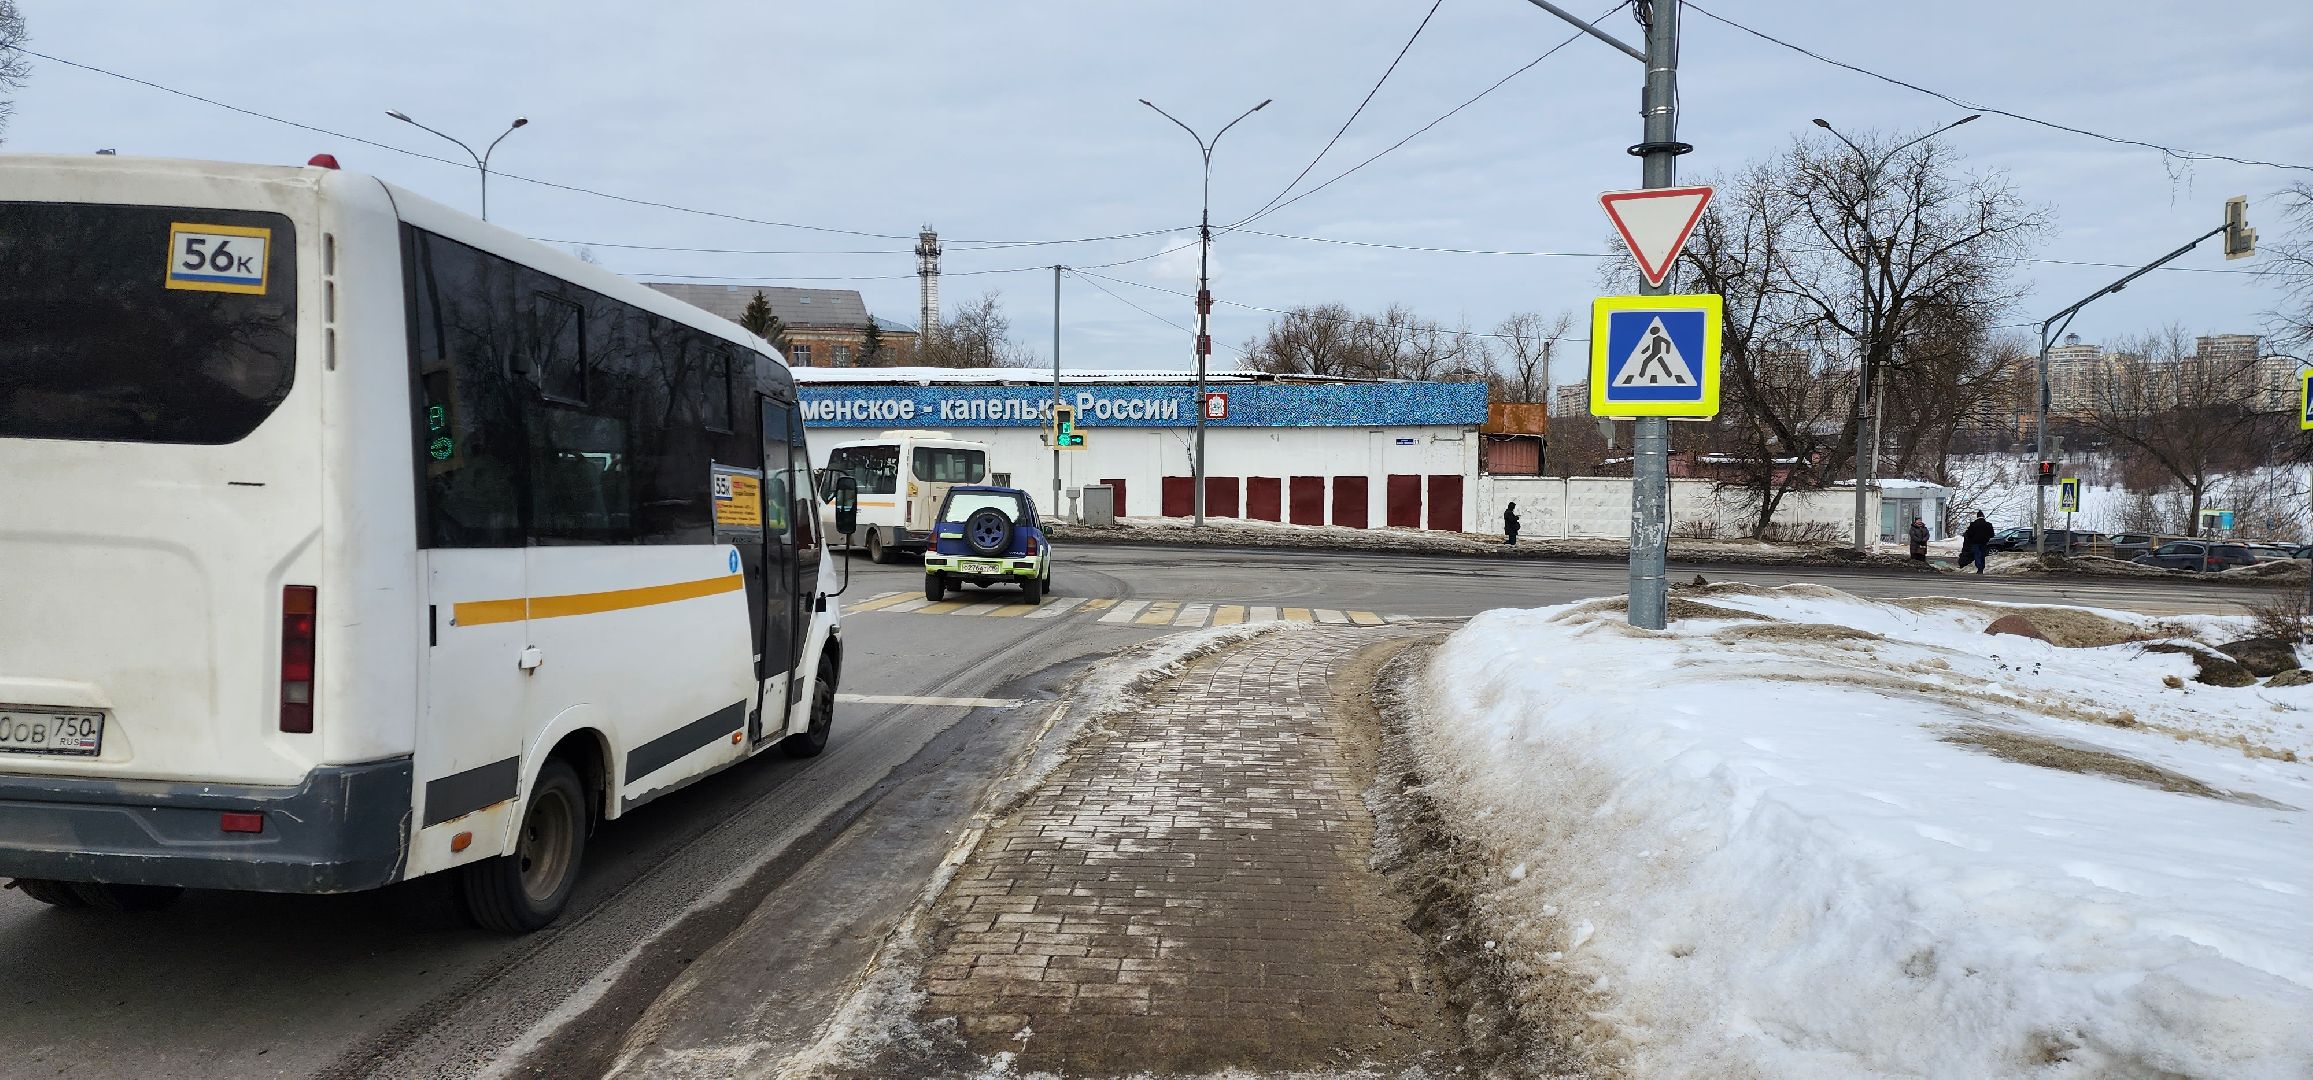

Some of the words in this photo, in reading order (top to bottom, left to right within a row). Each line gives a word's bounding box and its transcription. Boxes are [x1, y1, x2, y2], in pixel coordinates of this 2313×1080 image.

[1077, 392, 1179, 420] России
[54, 715, 92, 737] 750
[59, 737, 80, 746] RUS
